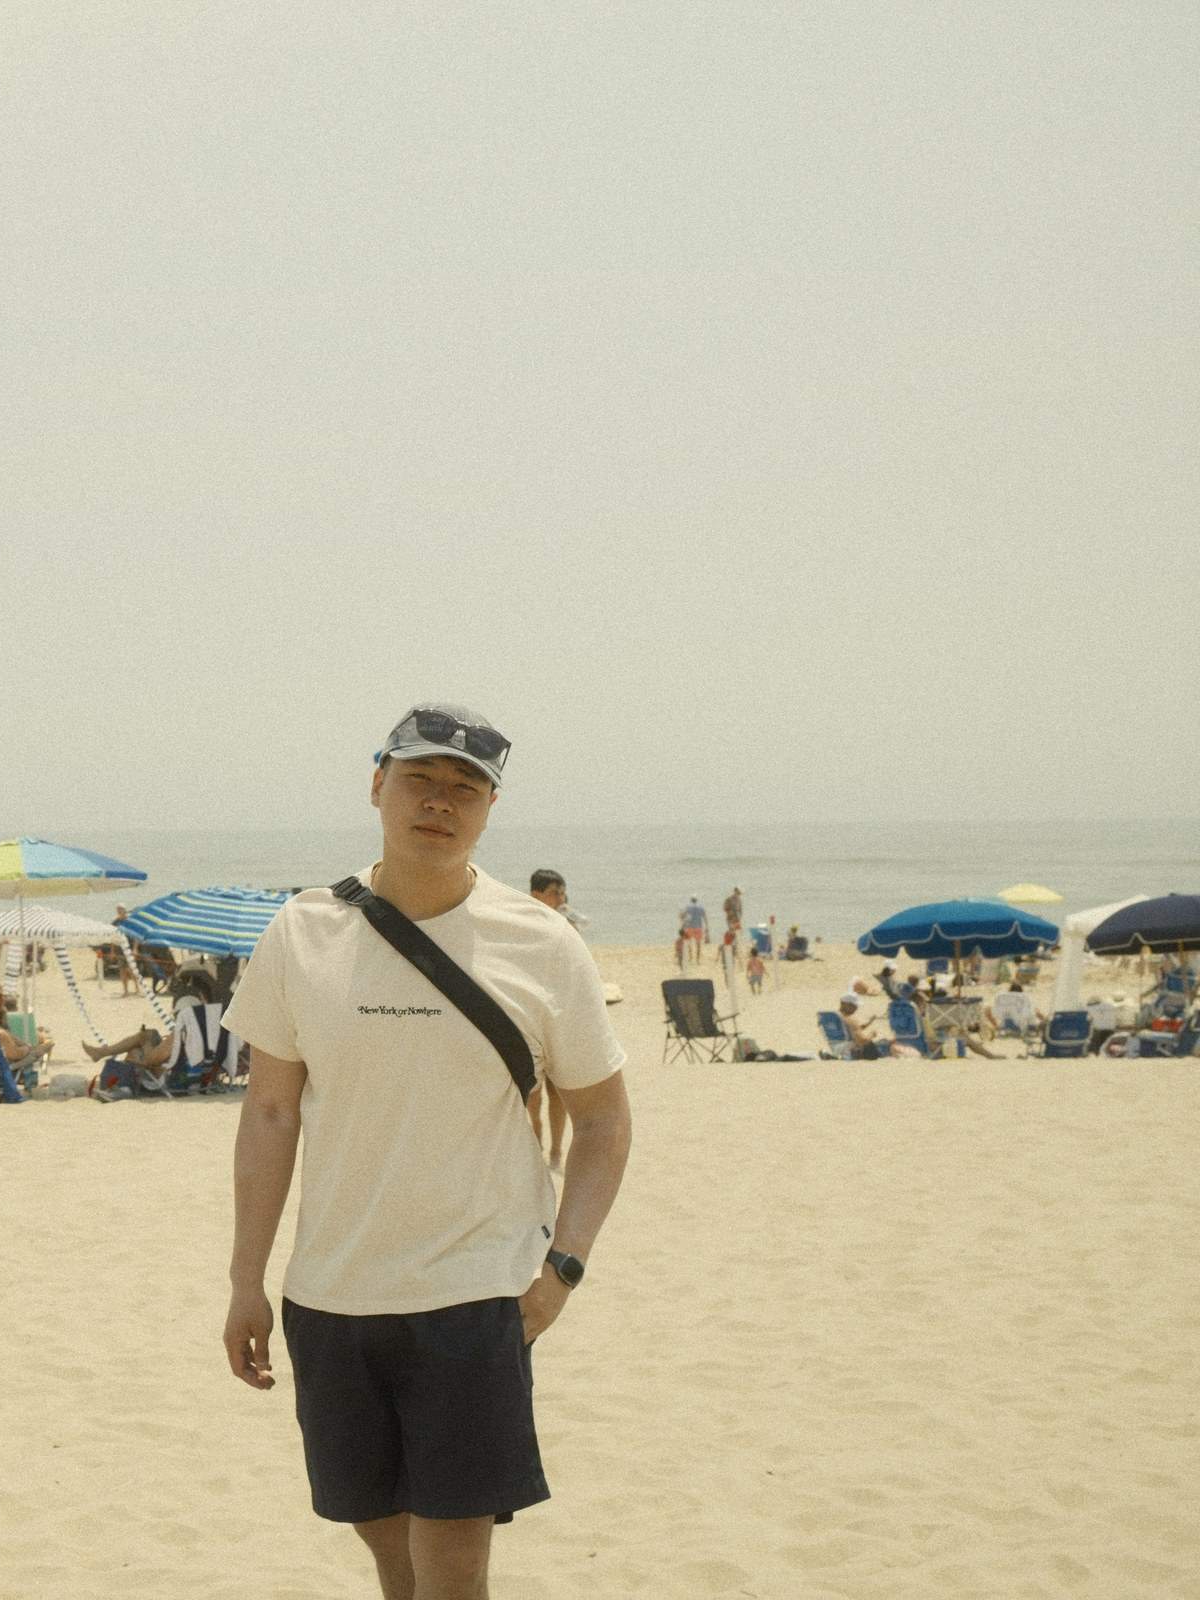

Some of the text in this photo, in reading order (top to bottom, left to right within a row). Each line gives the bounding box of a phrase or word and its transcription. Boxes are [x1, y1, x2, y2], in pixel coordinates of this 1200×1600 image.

[357, 1006, 442, 1017] New York or Nowhere
